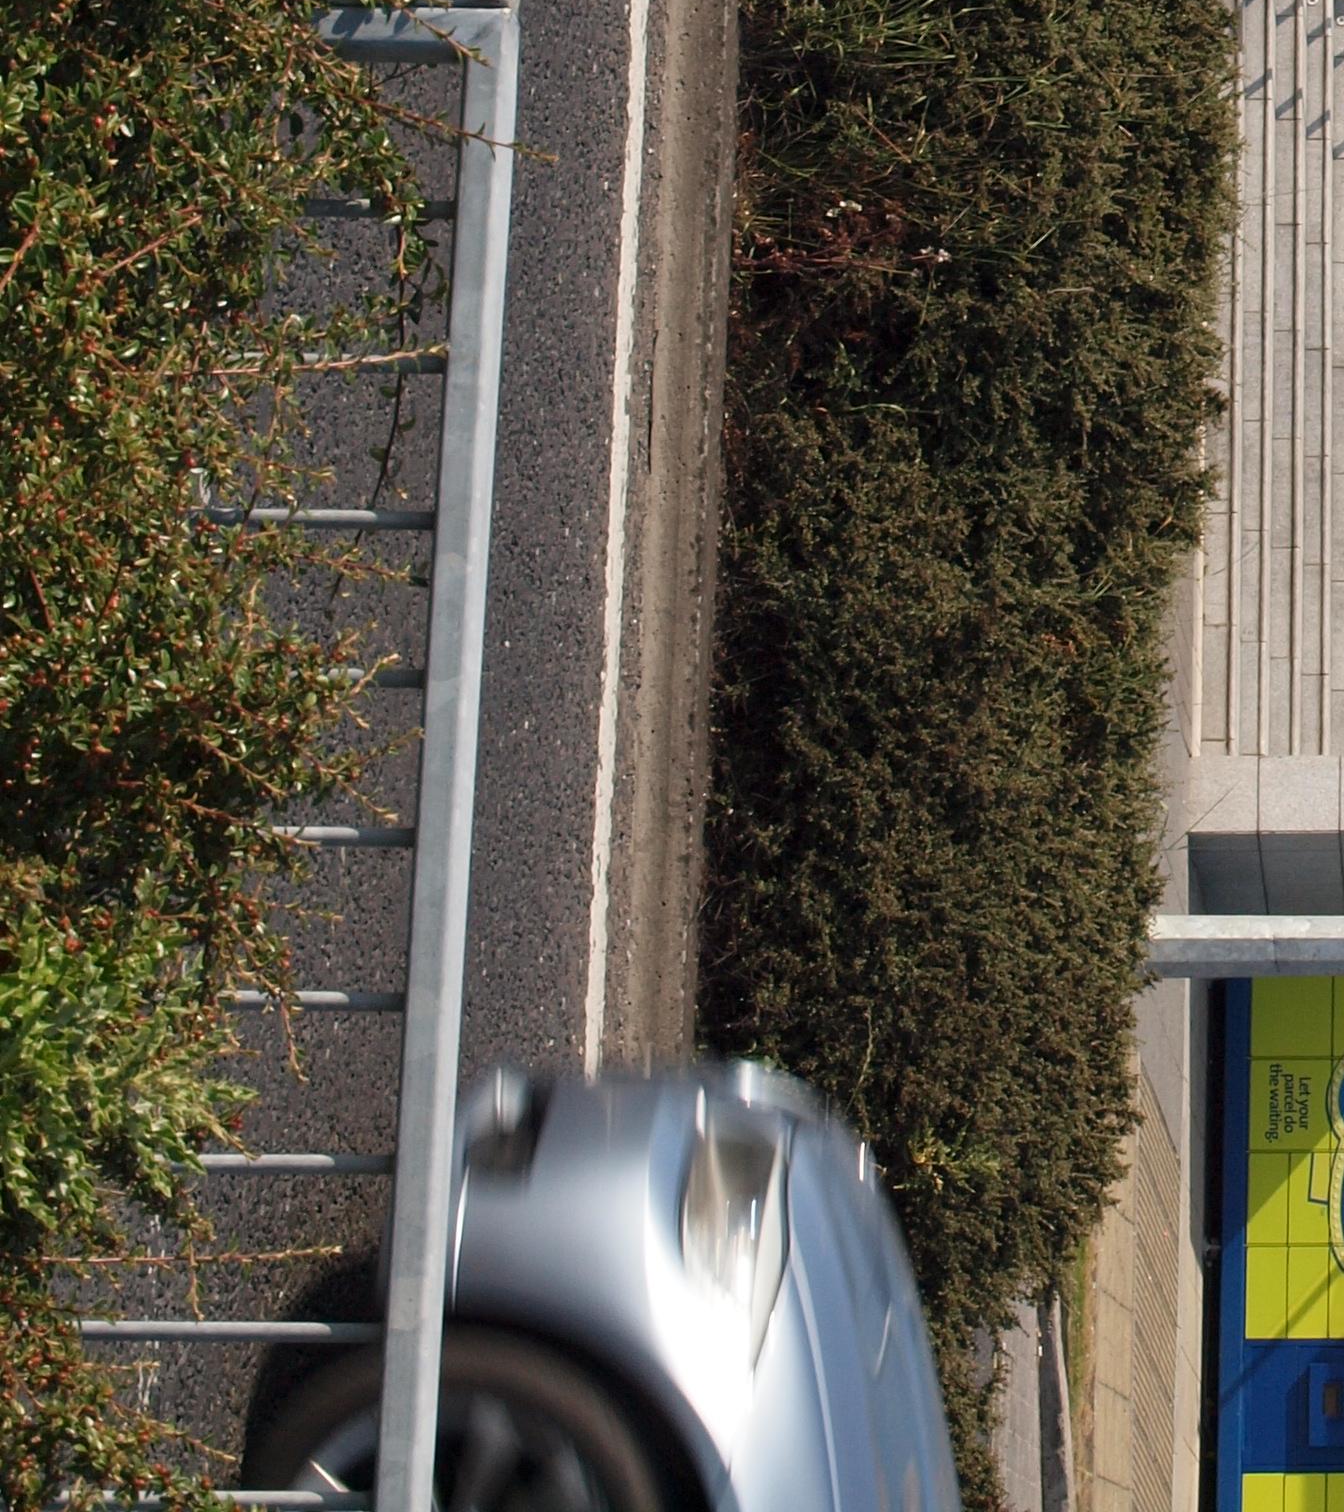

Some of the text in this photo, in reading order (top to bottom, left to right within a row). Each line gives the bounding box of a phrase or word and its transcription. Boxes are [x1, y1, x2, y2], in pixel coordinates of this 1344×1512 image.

[1265, 1064, 1282, 1143] the waiting.
[1281, 1073, 1297, 1134] parcel do
[1295, 1077, 1313, 1130] Let your
